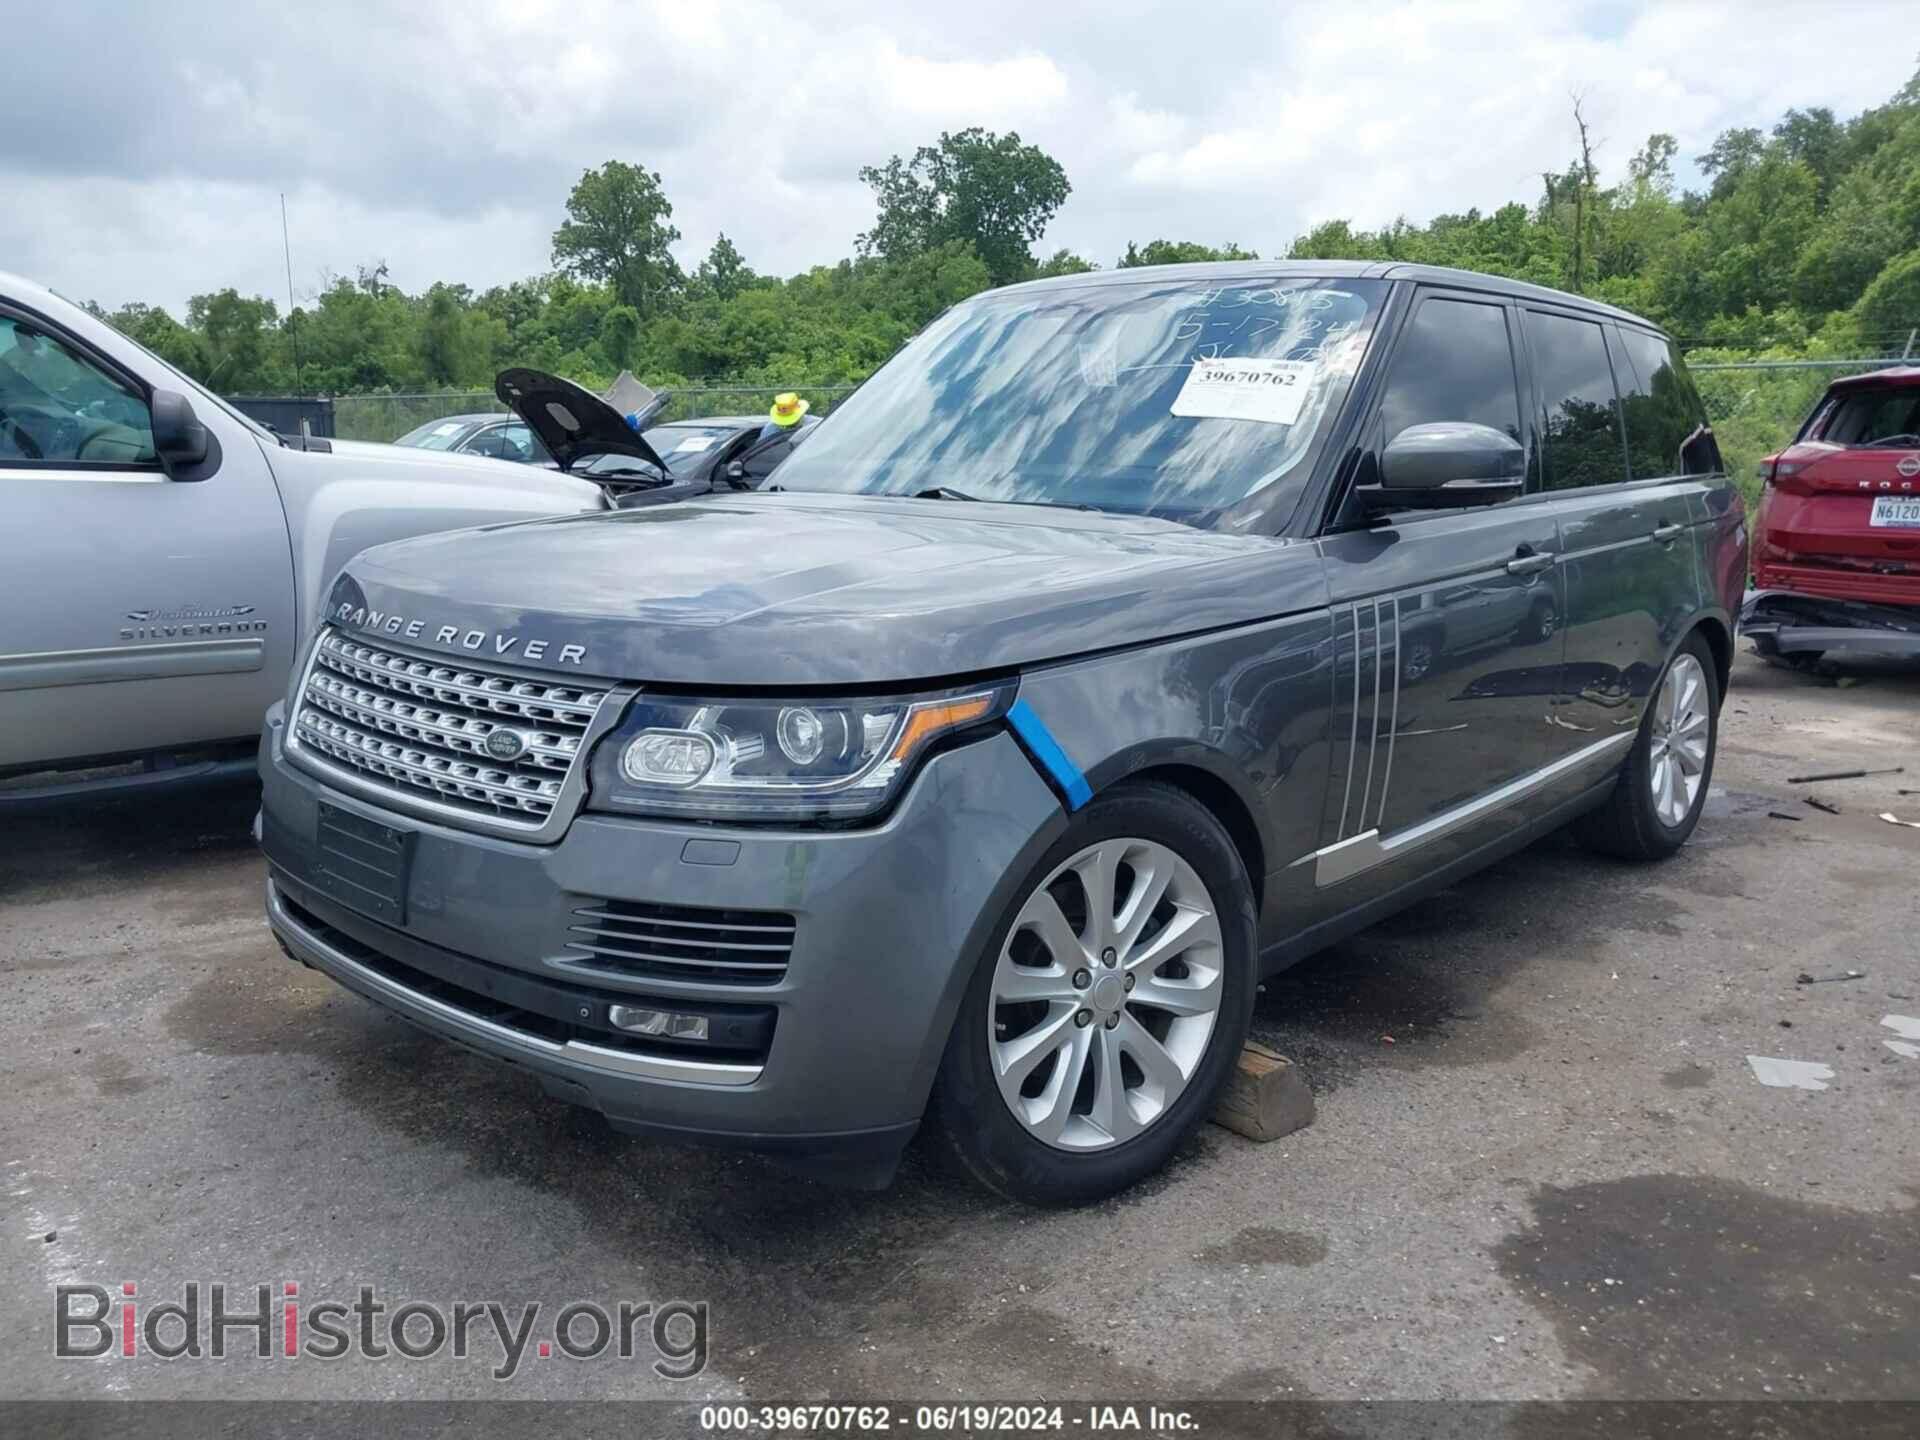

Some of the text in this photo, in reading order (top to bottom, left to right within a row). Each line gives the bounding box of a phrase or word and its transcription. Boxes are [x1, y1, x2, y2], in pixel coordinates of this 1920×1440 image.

[1200, 371, 1296, 386] 39670762
[1876, 505, 1920, 519] N6120
[120, 620, 268, 641] SILVERADO
[336, 602, 586, 665] RANGE ROVER
